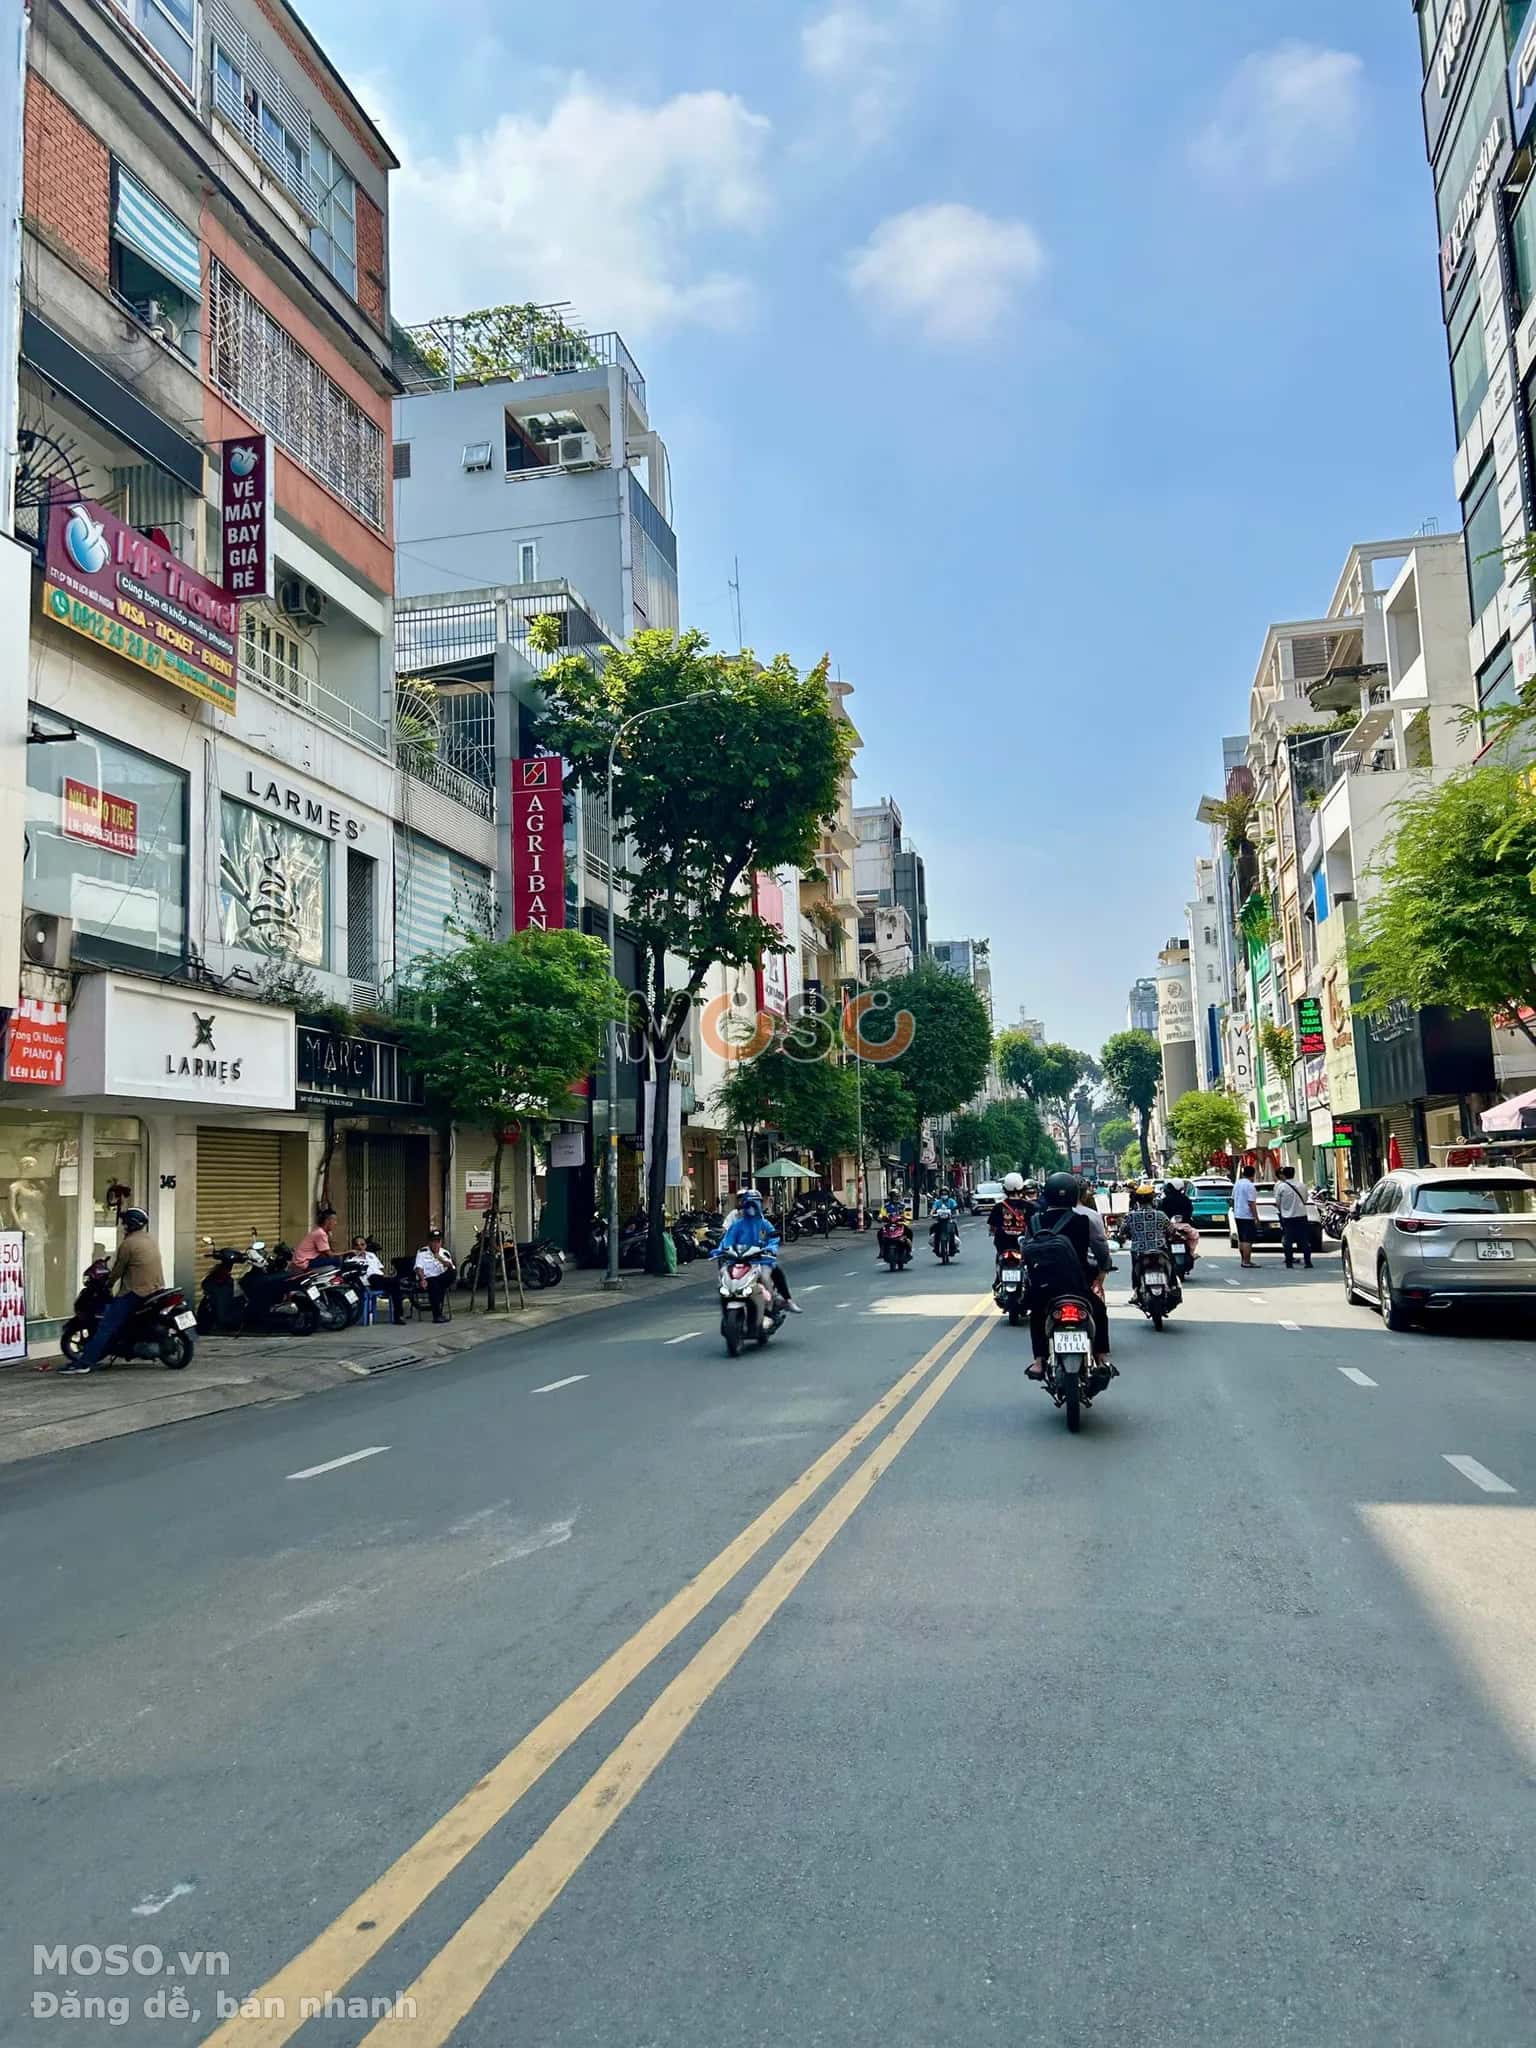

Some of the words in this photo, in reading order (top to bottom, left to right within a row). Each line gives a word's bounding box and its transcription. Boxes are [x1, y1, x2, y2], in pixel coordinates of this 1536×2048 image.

[233, 476, 255, 498] VÉ
[225, 499, 263, 522] MÁY
[227, 524, 260, 544] BAY
[229, 544, 258, 567] GIÁ
[232, 566, 255, 589] RẺ
[117, 598, 147, 629] VISA
[155, 621, 195, 655] TICKET
[201, 648, 234, 678] EVENT
[23, 1047, 52, 1061] PIANO
[160, 1175, 177, 1190] 345
